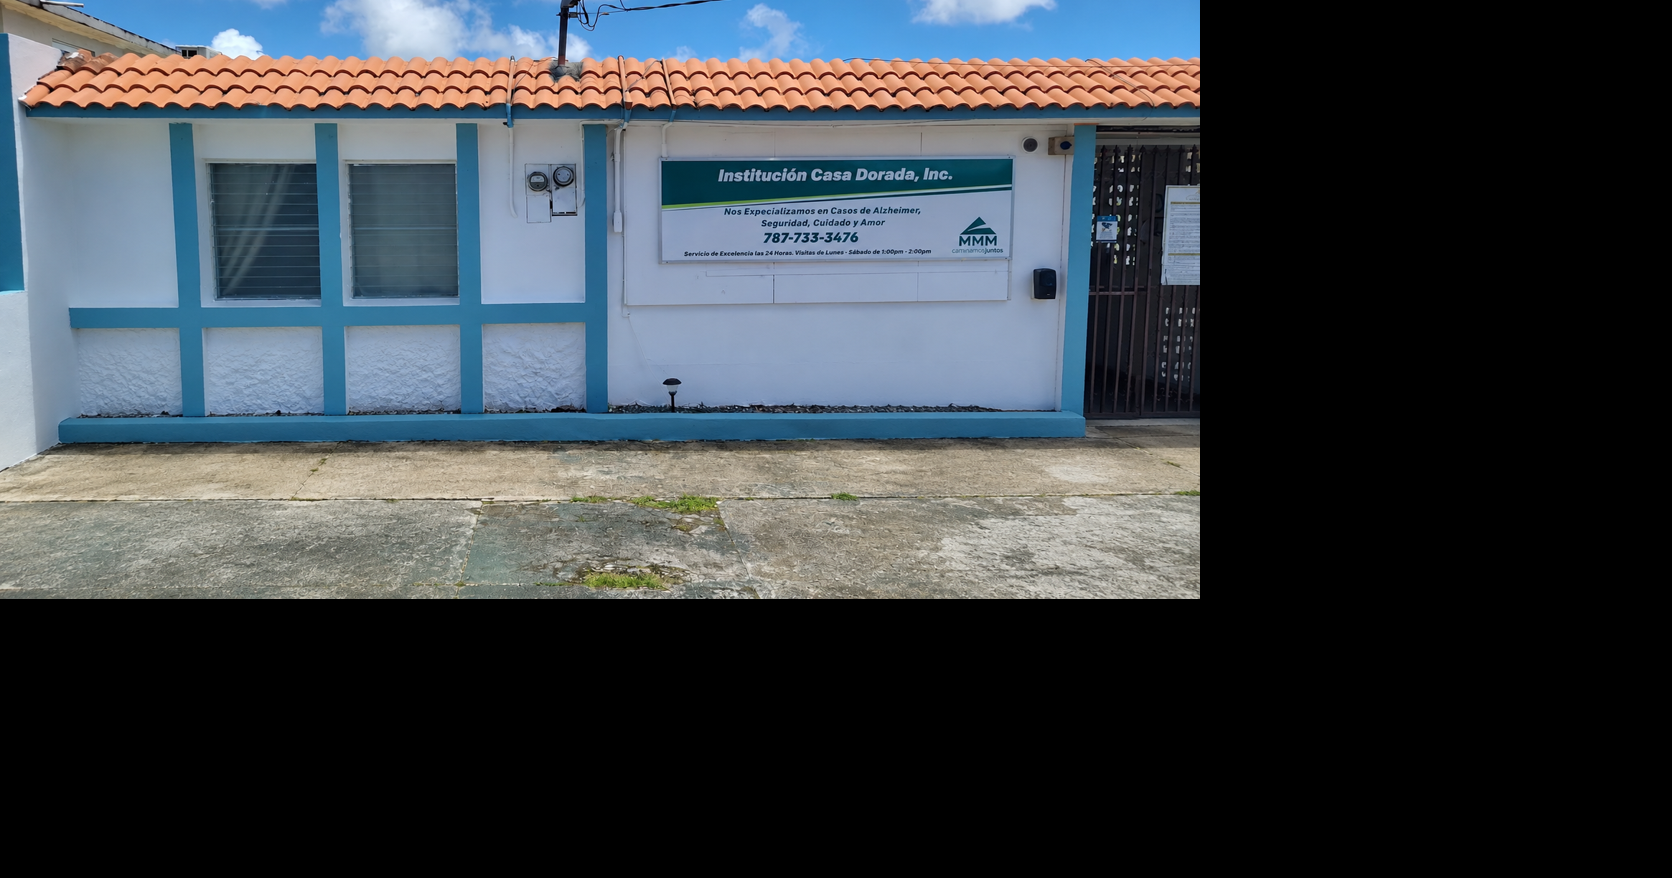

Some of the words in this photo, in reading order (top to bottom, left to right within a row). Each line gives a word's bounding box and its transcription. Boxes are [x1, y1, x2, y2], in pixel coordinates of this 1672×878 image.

[718, 168, 807, 182] Institución
[810, 168, 852, 182] Casa
[855, 168, 920, 182] Dorada,
[923, 167, 953, 181] Inc.
[724, 207, 742, 216] Nos
[744, 207, 816, 217] Expecializamos
[817, 208, 829, 216] en
[830, 207, 858, 215] Casos
[860, 207, 871, 215] de
[873, 206, 922, 216] Alzheimer,
[761, 219, 810, 229] Seguridad,
[813, 218, 851, 227] Cuidado
[853, 220, 859, 228] y
[860, 218, 886, 227] Amor
[763, 231, 859, 244] 787-733-3476
[958, 235, 998, 247] MMM
[881, 248, 904, 256] 1:00pm
